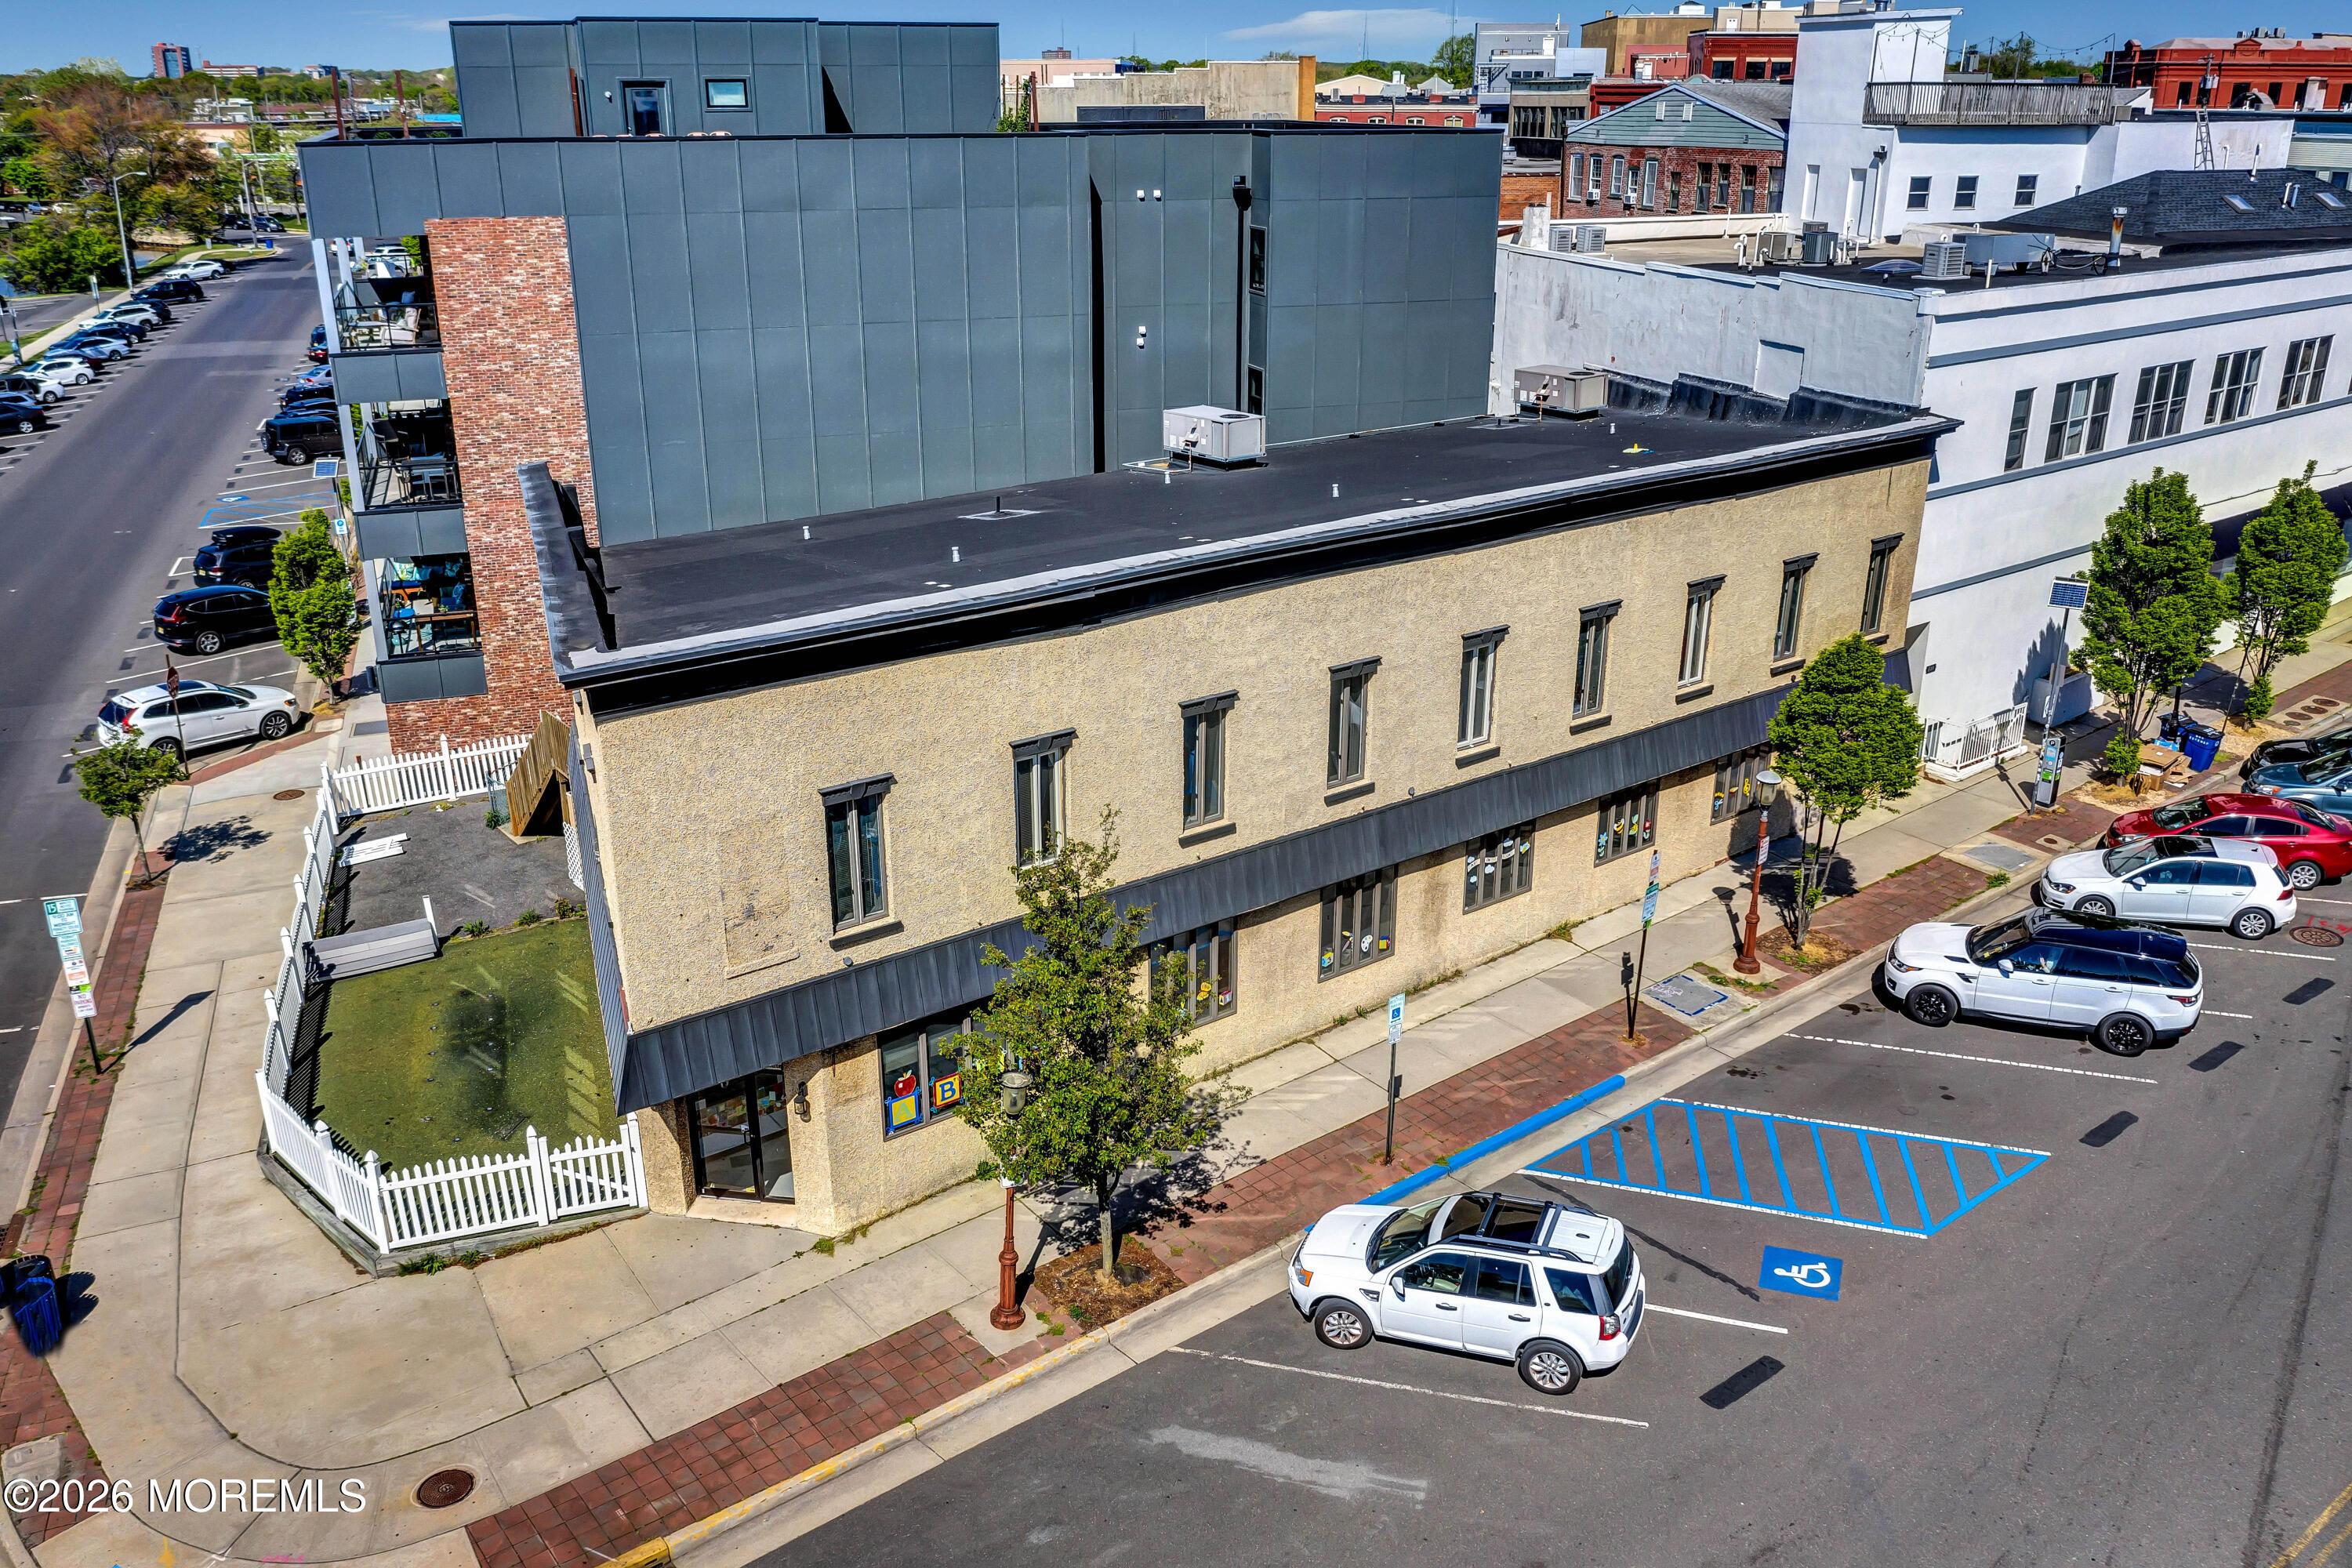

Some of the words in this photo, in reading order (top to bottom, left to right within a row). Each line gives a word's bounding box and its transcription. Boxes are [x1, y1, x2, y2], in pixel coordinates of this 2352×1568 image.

[47, 903, 56, 913] 15
[895, 1103, 913, 1123] A
[939, 1080, 956, 1102] B
